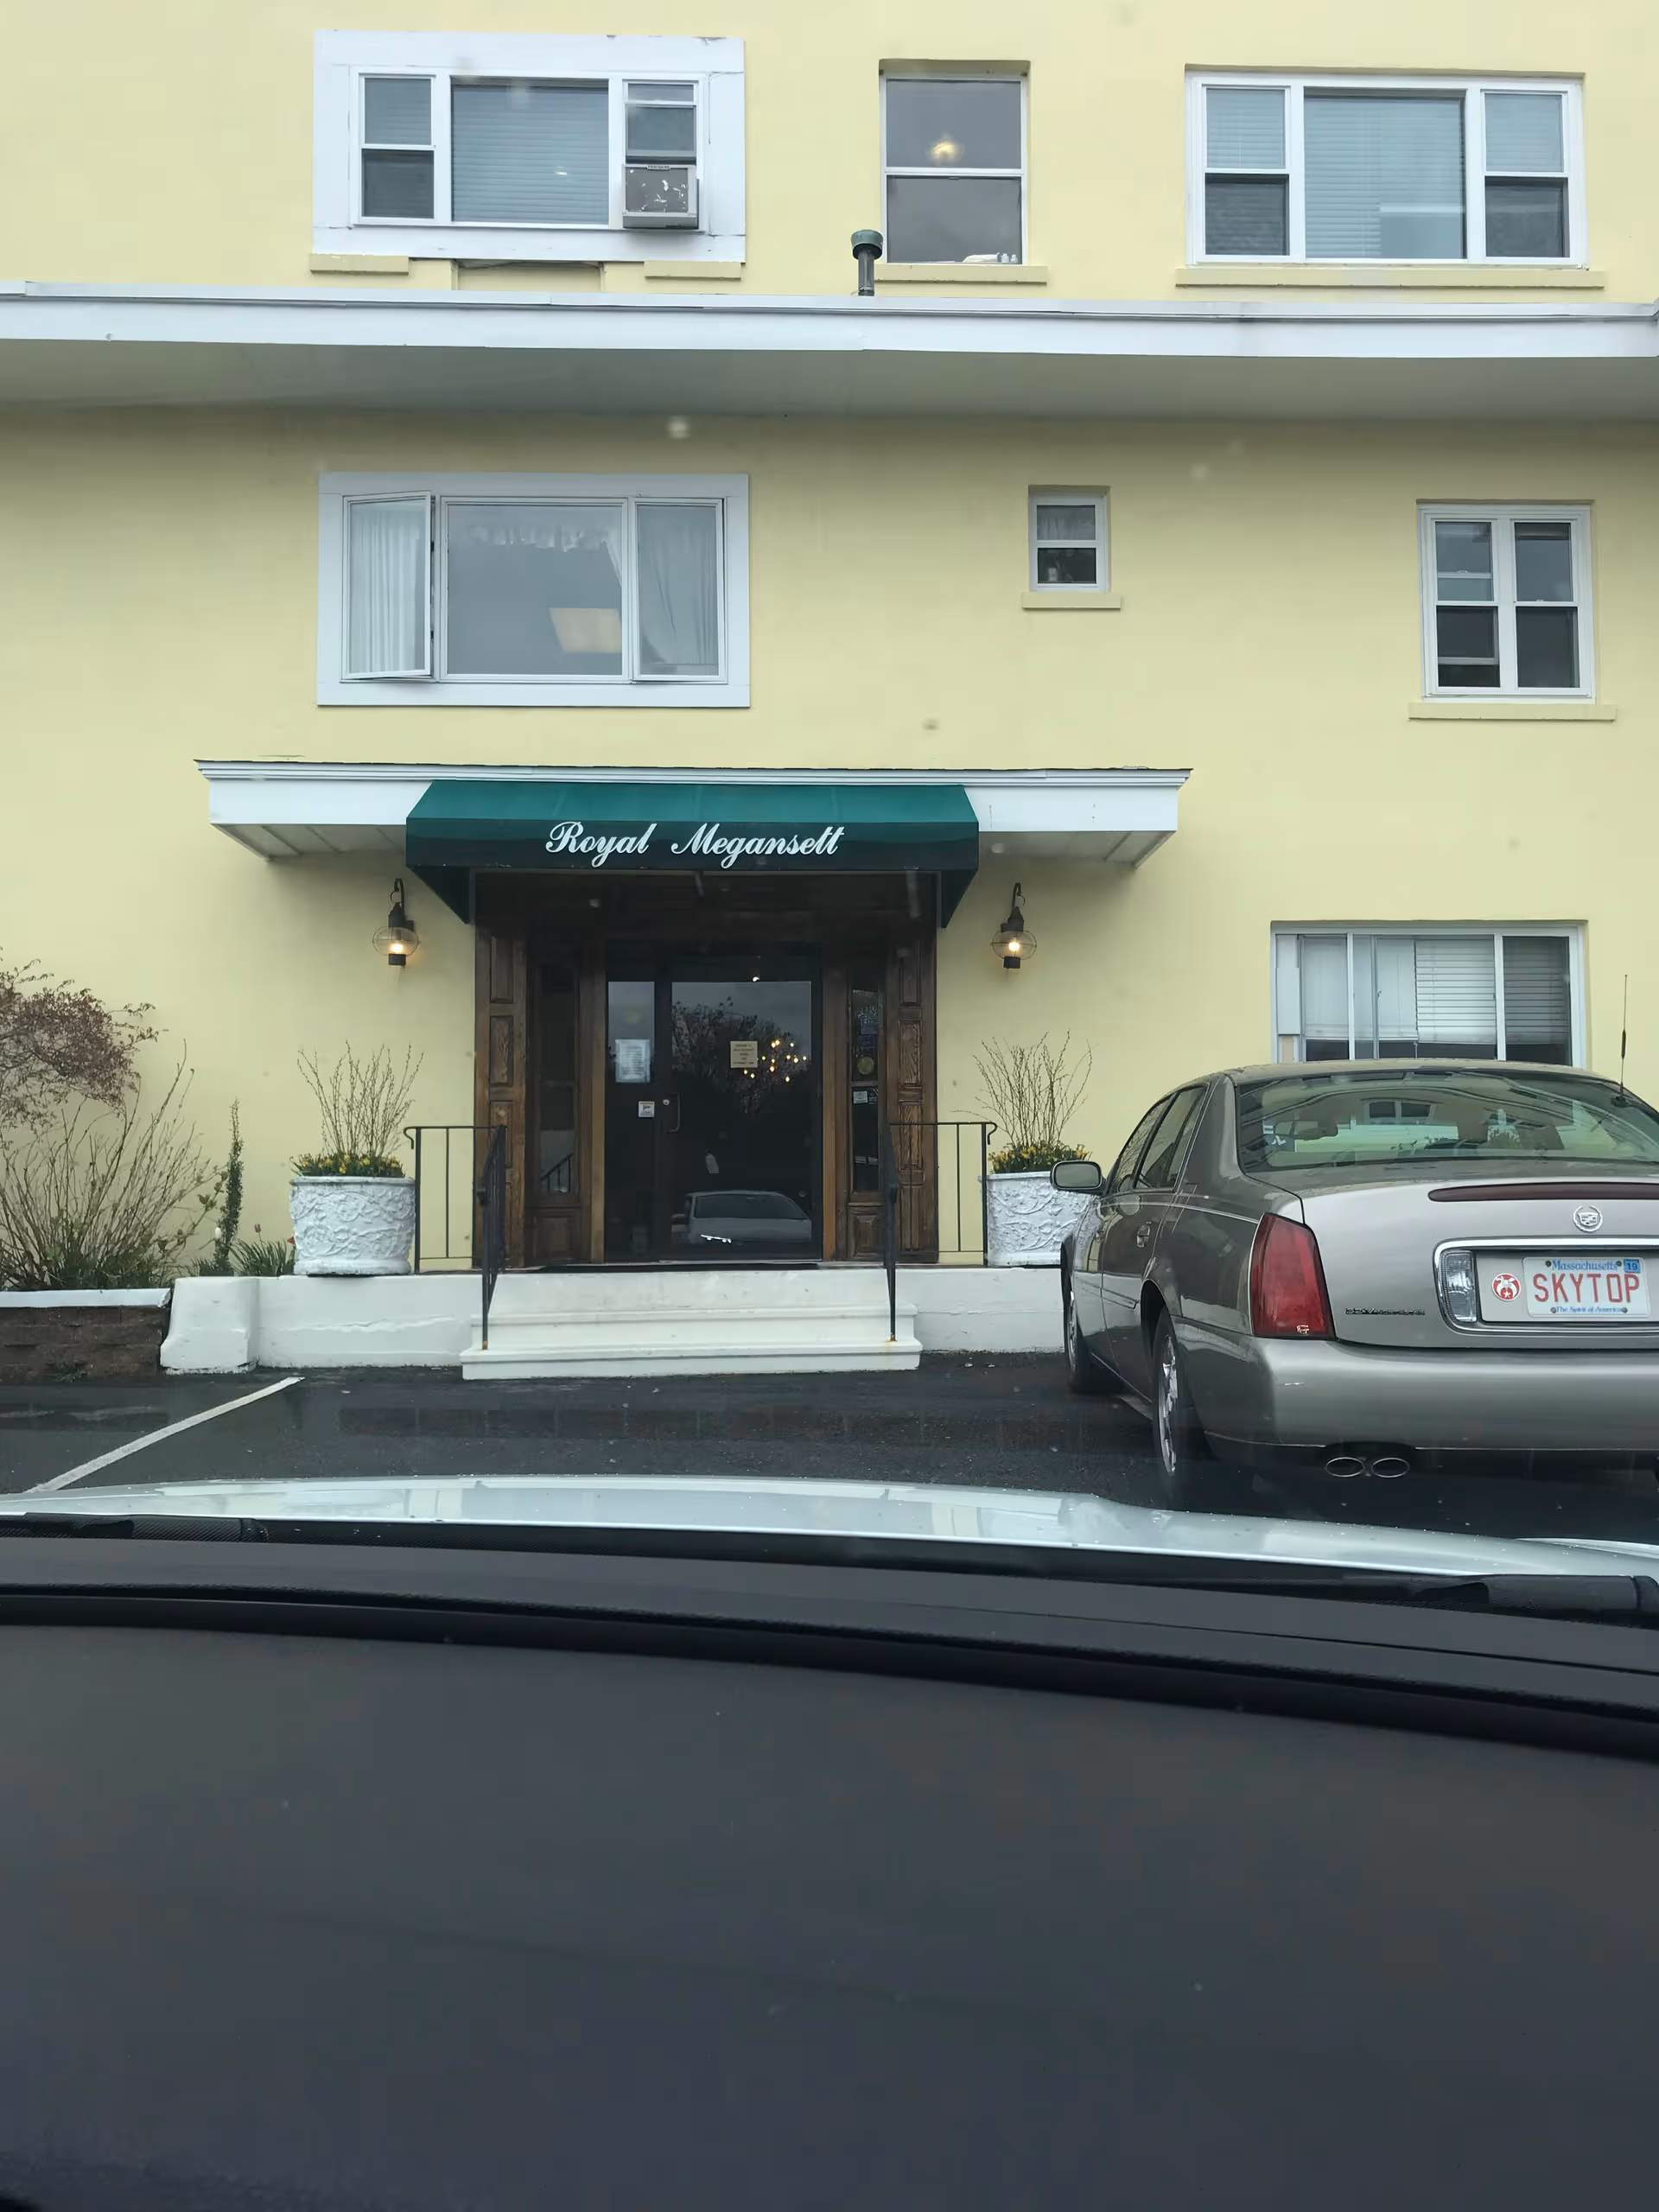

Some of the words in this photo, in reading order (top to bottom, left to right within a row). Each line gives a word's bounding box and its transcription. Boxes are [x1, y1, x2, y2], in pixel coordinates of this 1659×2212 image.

[545, 821, 658, 868] Royal
[671, 823, 845, 868] Megansett
[1552, 1259, 1618, 1271] Massachusetts
[1626, 1262, 1638, 1271] 19
[1533, 1274, 1640, 1303] SKYTOP
